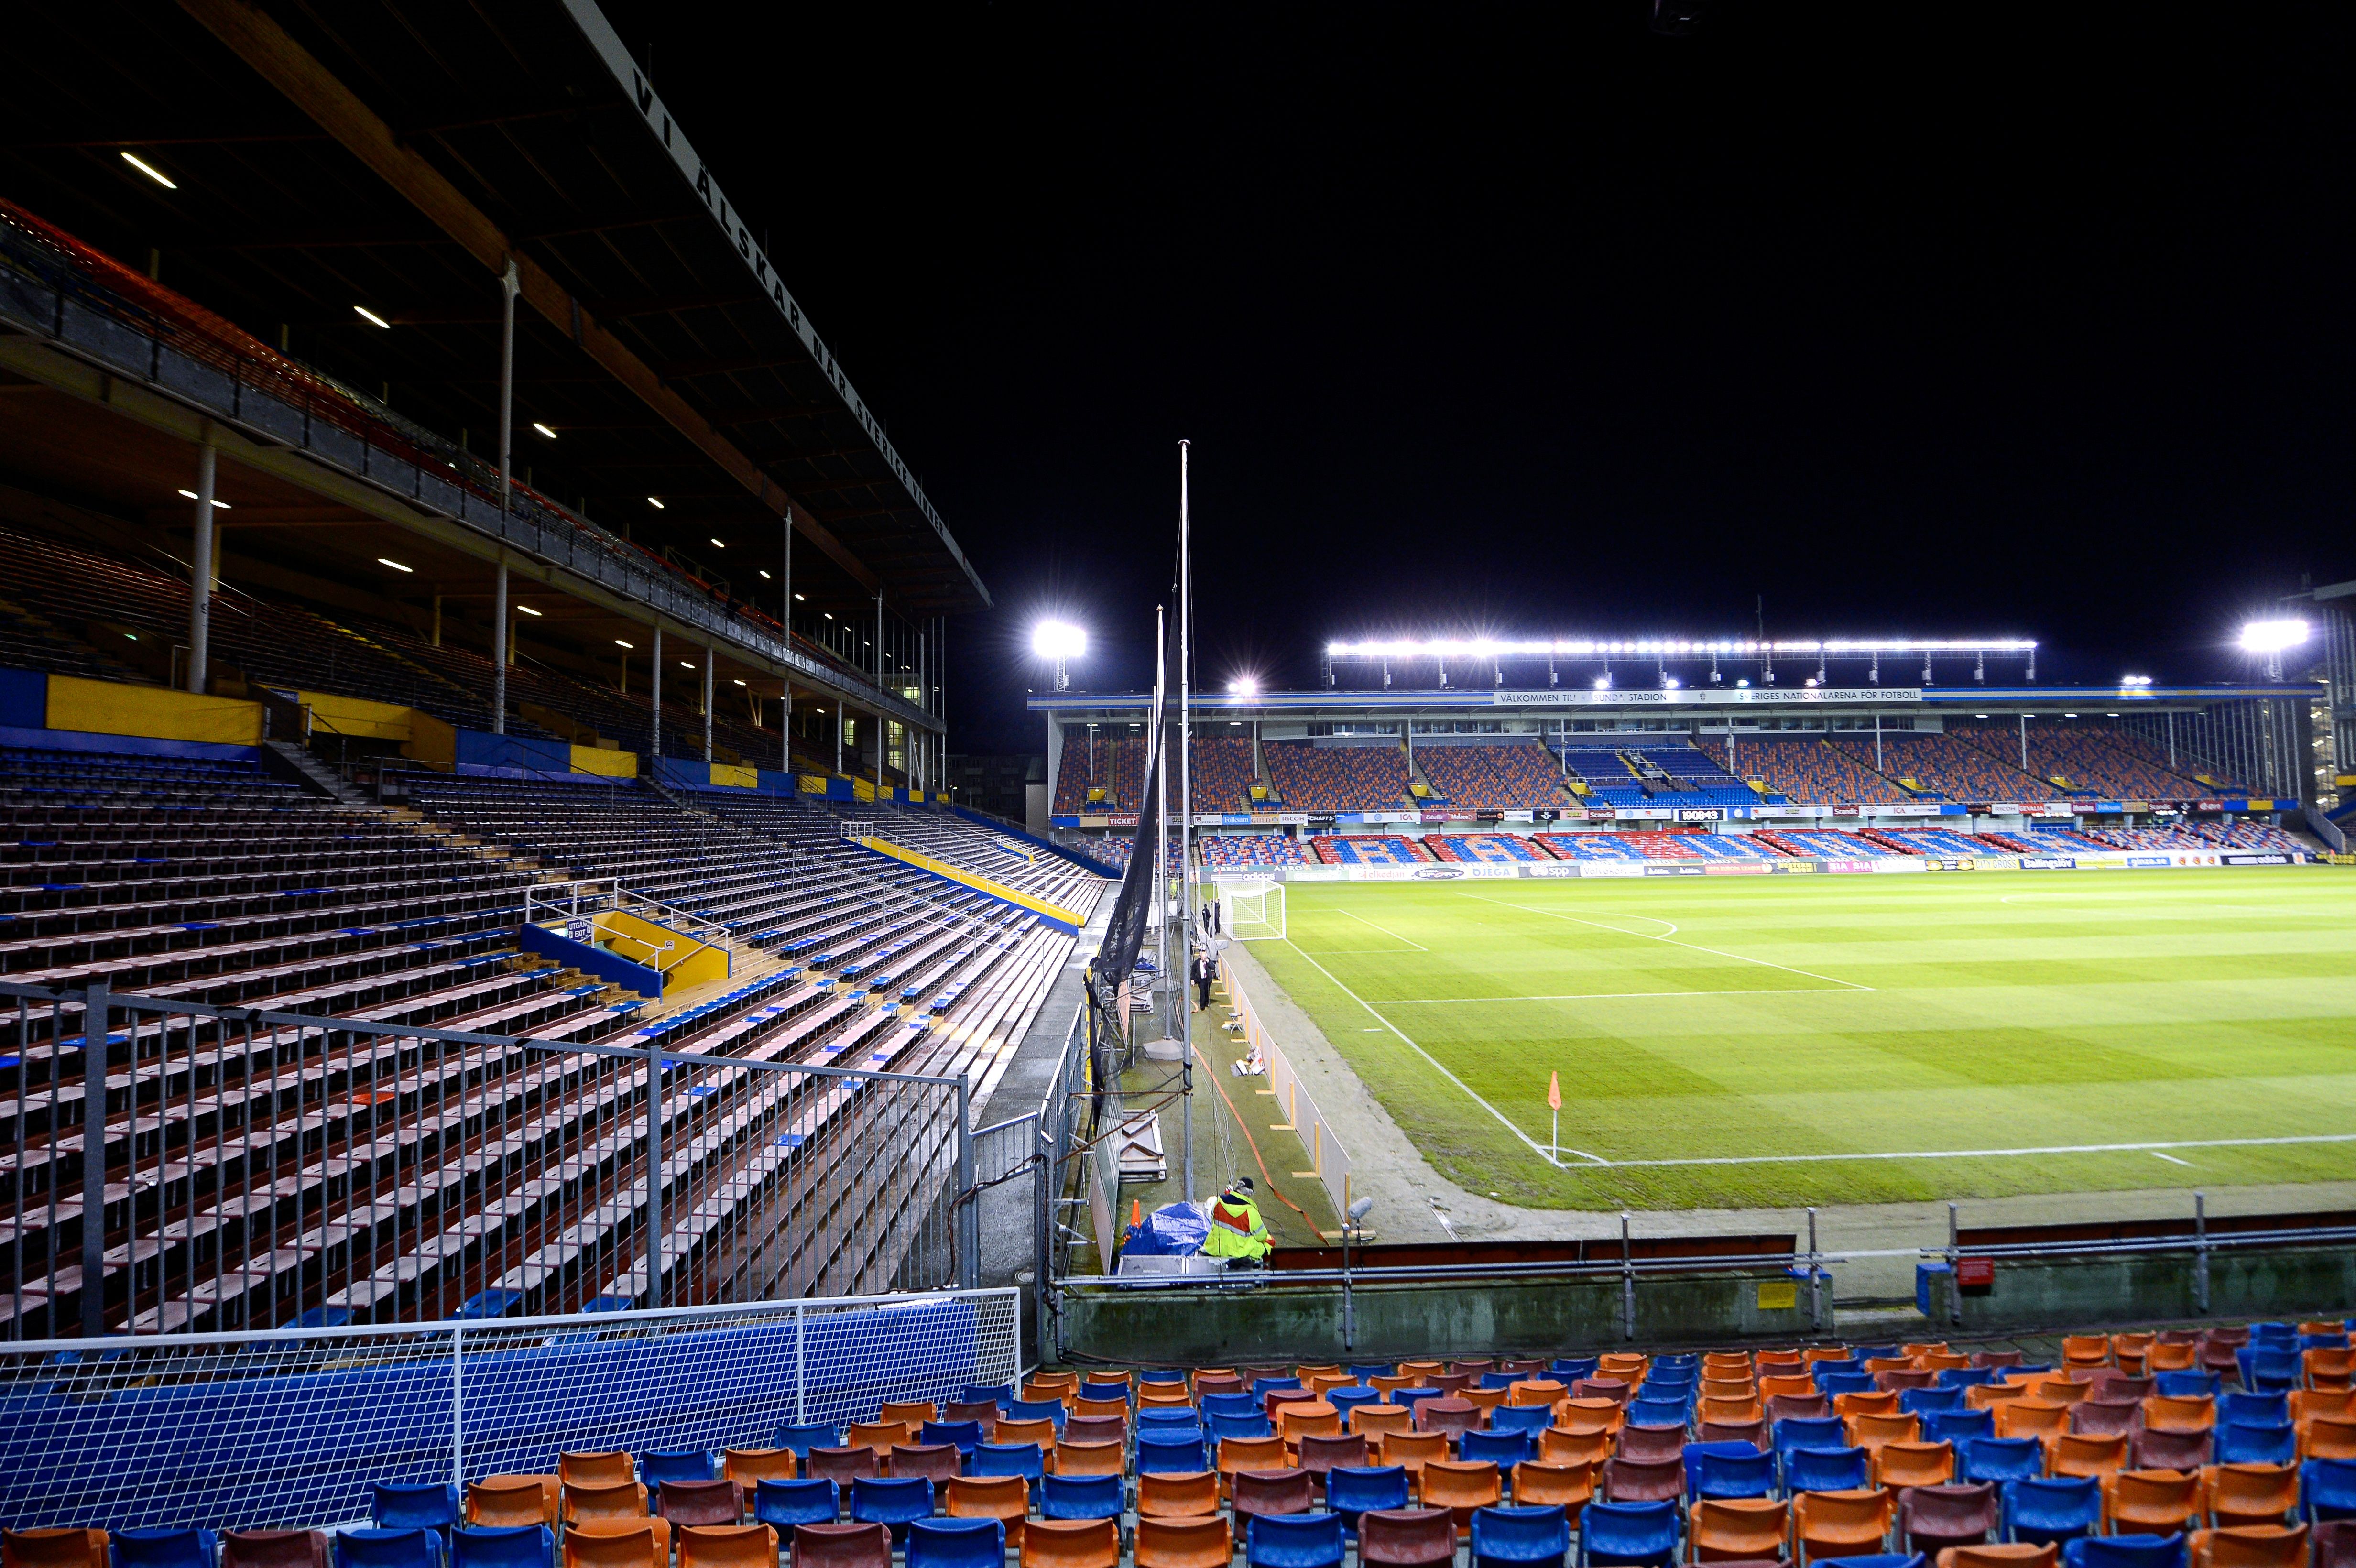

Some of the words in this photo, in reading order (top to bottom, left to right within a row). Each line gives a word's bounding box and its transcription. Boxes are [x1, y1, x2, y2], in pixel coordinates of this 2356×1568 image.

[633, 68, 670, 150] VI
[696, 160, 800, 333] ÄLSKAR
[813, 334, 846, 398] NÄR
[857, 400, 907, 486] SVERIGE
[913, 481, 943, 536] VINNER
[1501, 694, 1558, 703] VÄLKOMMEN
[1629, 693, 1666, 701] STADION
[1783, 690, 1857, 699] NATIONALARENA
[1861, 689, 1877, 698] FÖR
[1881, 690, 1918, 698] FOTBOLL
[1976, 860, 1991, 869] CITY
[1993, 860, 2017, 868] GROSS
[2024, 859, 2072, 869] Ballingslöv
[1243, 872, 1275, 881] adidas
[1549, 867, 1570, 877] spp
[575, 929, 586, 937] EXIT
